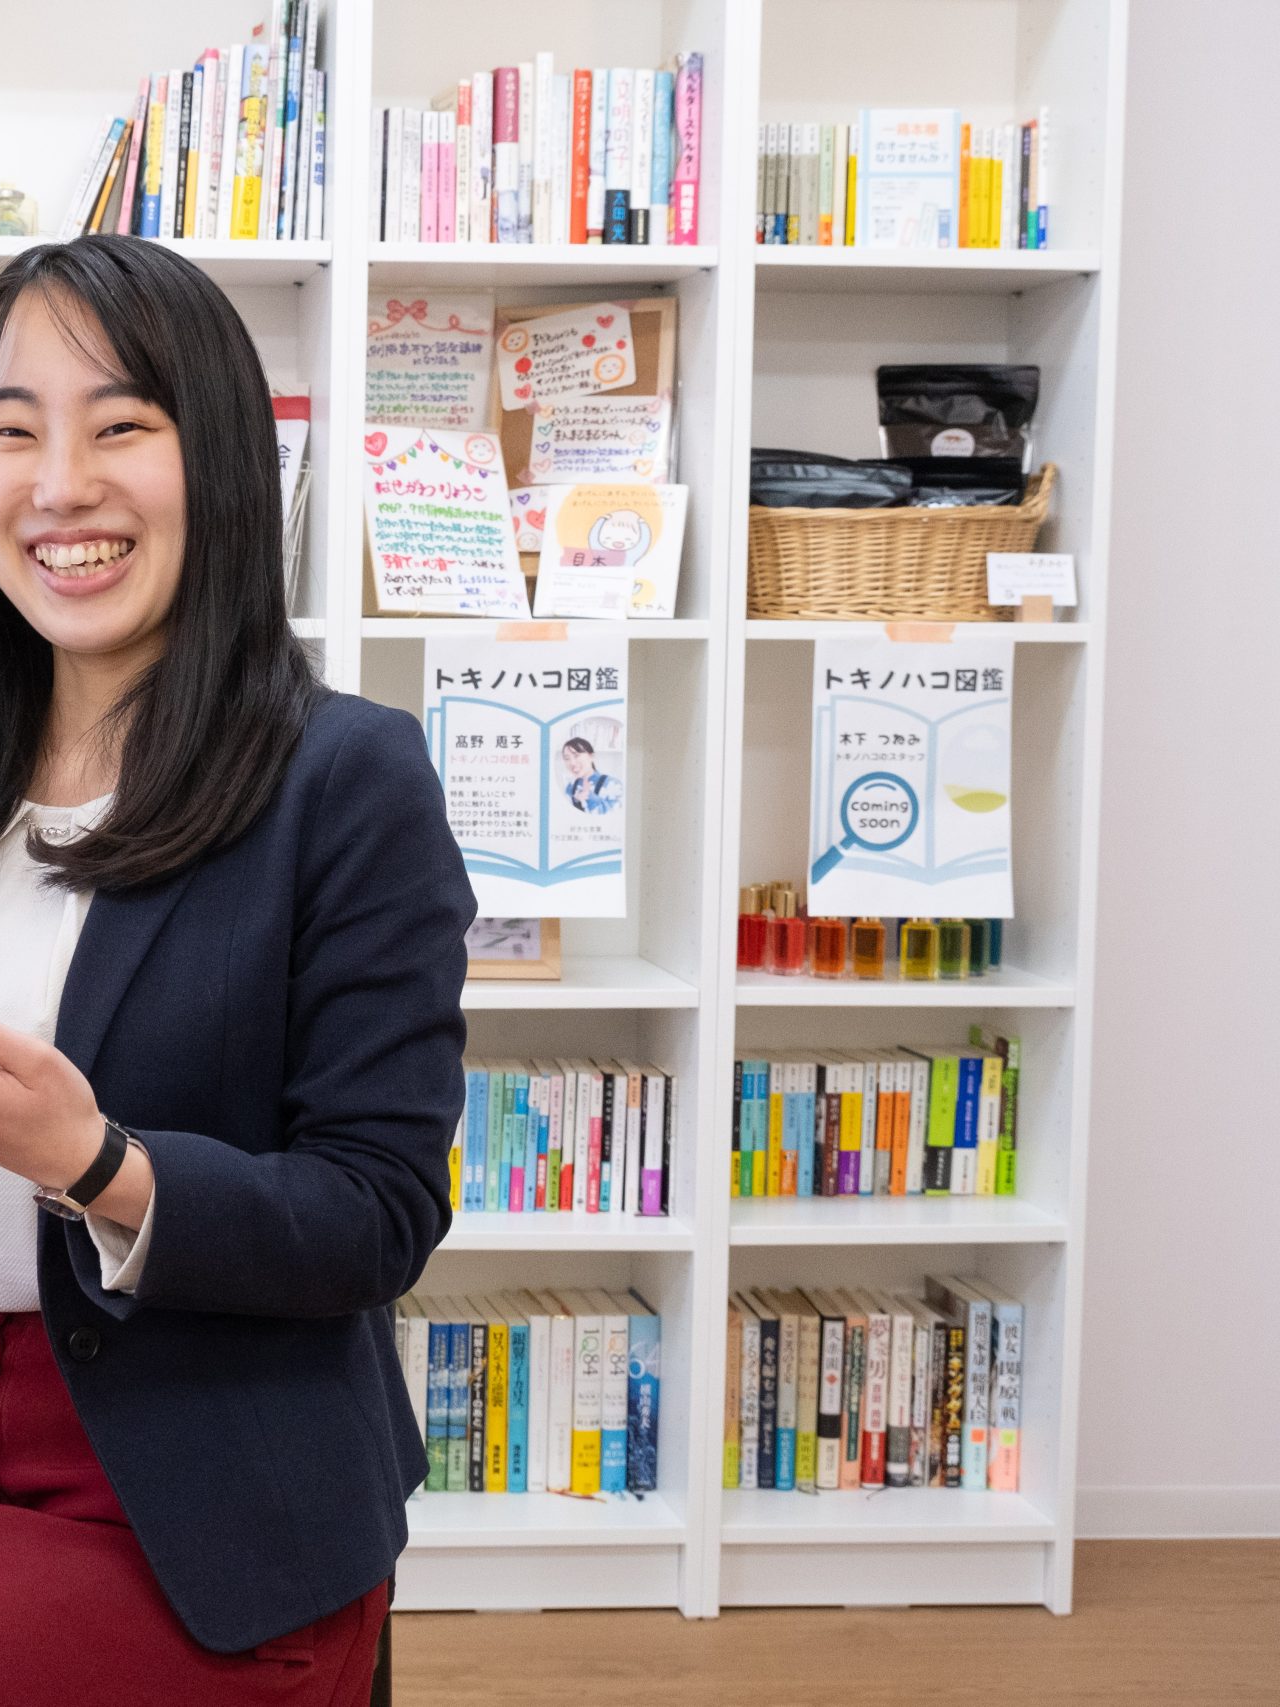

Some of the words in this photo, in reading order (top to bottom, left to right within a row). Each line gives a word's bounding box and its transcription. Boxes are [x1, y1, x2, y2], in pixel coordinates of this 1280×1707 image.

[436, 667, 619, 691] トキノハコ図鑑
[826, 667, 1004, 692] トキノハコ図鑑
[840, 733, 867, 746] 木下
[837, 753, 925, 762] トキノハコのスタッフ
[851, 800, 909, 813] coming
[859, 817, 901, 828] soon
[582, 1328, 600, 1376] 1Q84
